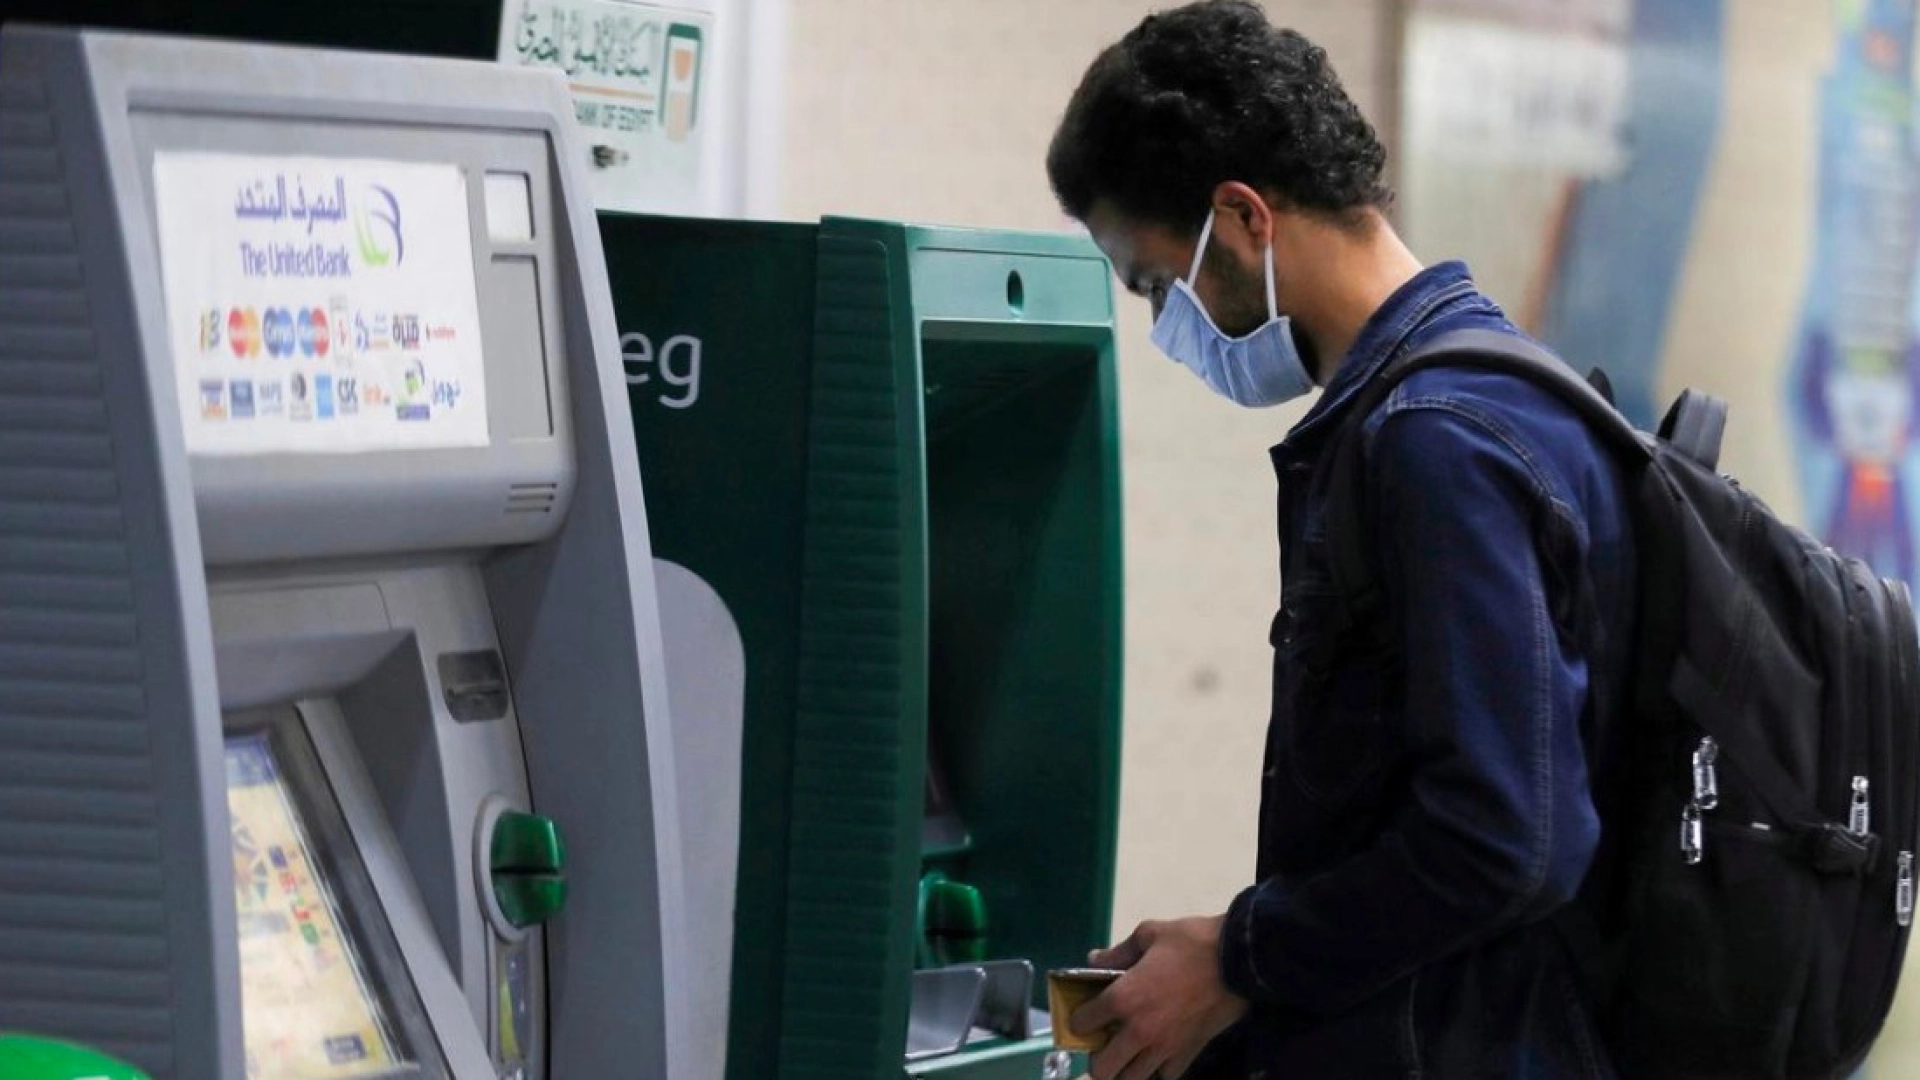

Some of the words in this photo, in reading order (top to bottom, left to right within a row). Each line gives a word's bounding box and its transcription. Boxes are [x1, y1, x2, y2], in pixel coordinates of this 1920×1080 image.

[572, 98, 597, 126] ANK
[601, 103, 618, 129] OF
[618, 106, 655, 133] EGYPT
[235, 172, 288, 222] المتحد
[290, 172, 347, 235] المصرف
[240, 241, 267, 277] The
[268, 241, 314, 278] United
[316, 243, 351, 278] Bank
